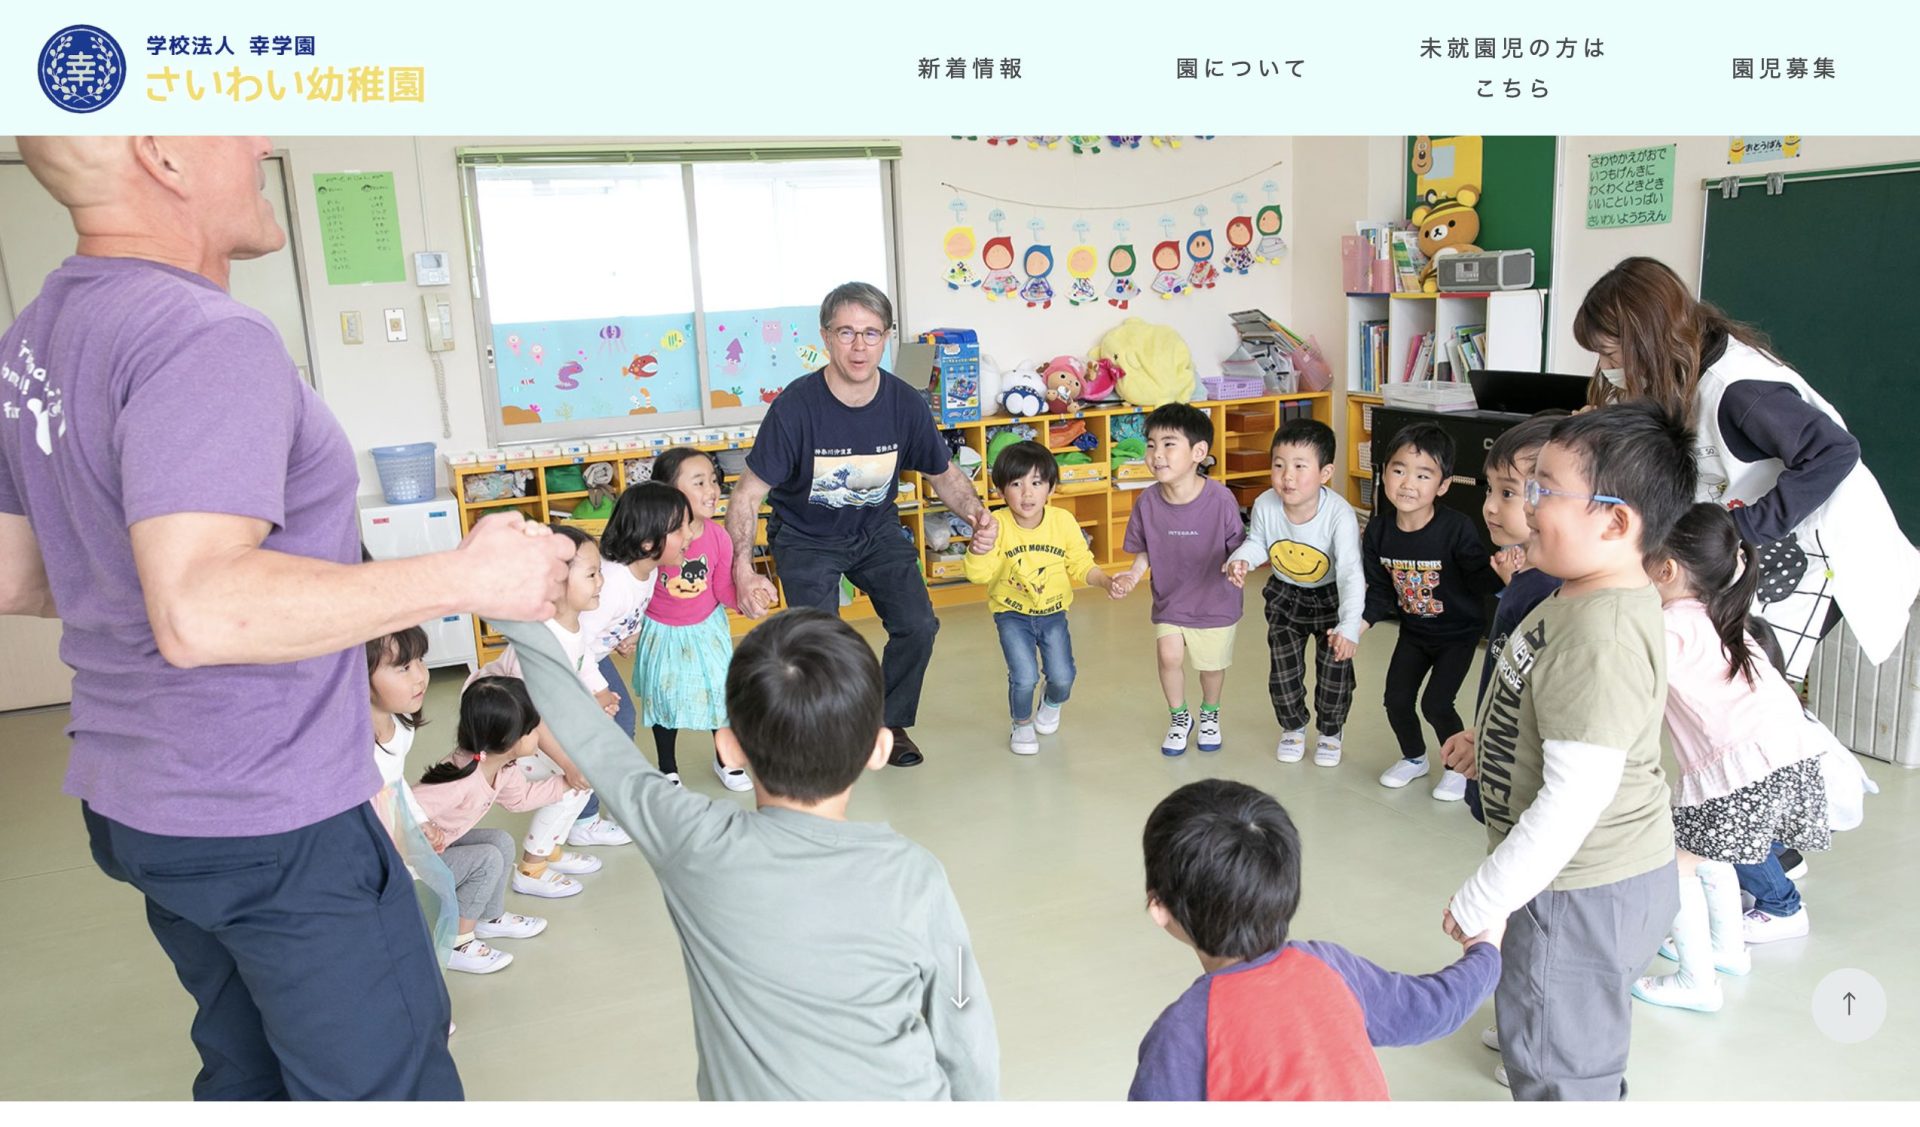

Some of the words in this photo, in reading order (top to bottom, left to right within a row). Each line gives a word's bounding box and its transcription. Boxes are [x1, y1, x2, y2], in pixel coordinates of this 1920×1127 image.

[1590, 147, 1667, 169] さわやかえがおで
[1590, 164, 1655, 182] いつもげんきに
[1590, 177, 1664, 196] わくわくどきどき
[1588, 192, 1664, 210] いいこといっぱい
[1587, 209, 1667, 227] さいわいようちえん
[1029, 543, 1066, 558] MONSTERS
